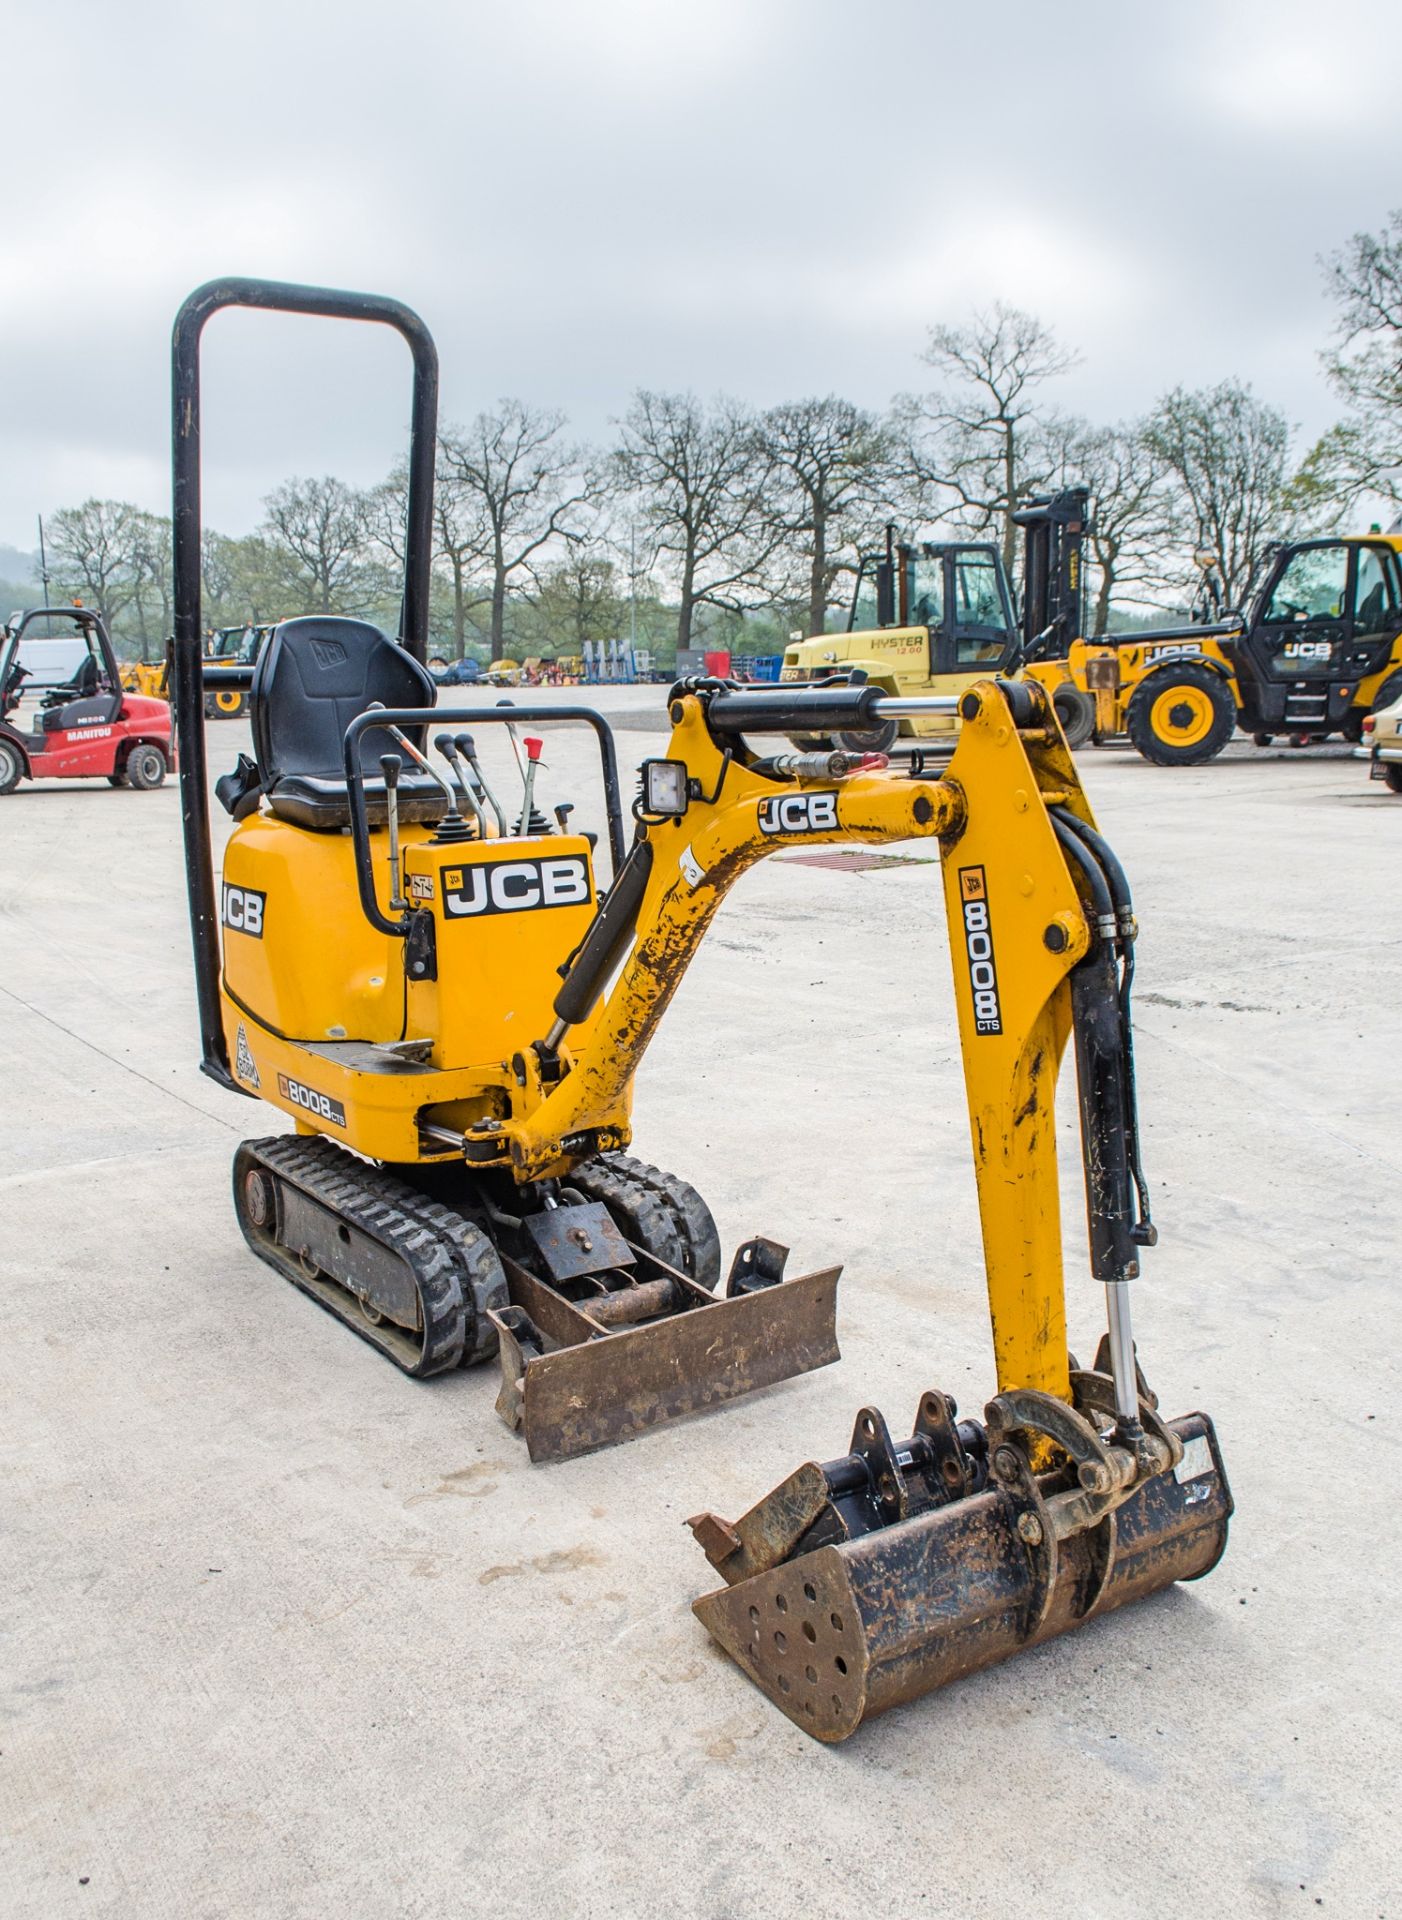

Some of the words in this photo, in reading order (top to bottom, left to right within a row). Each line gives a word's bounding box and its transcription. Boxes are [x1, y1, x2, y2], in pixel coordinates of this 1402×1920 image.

[870, 636, 923, 649] HYSTER
[1284, 642, 1332, 658] JCB
[67, 728, 112, 741] MANITOU
[759, 795, 838, 832] JCB
[447, 859, 588, 915] JCB
[965, 902, 998, 1019] 8008
[977, 1020, 1000, 1031] CTS
[288, 1080, 332, 1120] 8008
[331, 1112, 345, 1126] CTS
